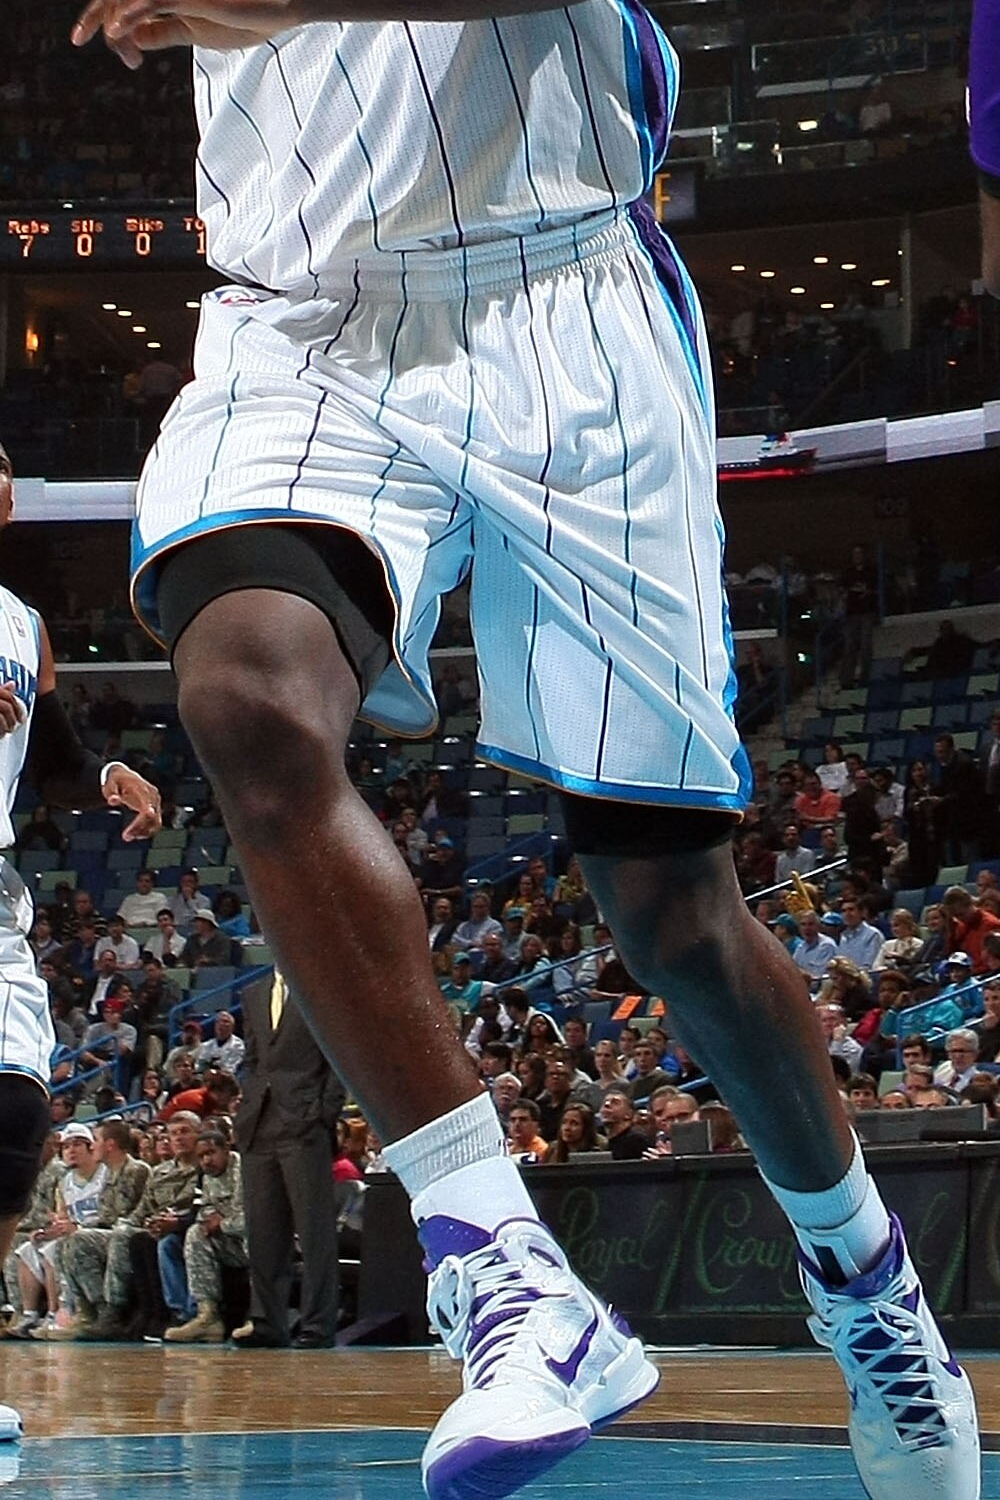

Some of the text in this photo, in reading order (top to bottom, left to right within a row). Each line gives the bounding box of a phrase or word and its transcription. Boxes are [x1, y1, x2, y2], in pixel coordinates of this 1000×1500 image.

[19, 234, 34, 258] 7
[76, 233, 93, 257] 0
[135, 232, 151, 256] 0
